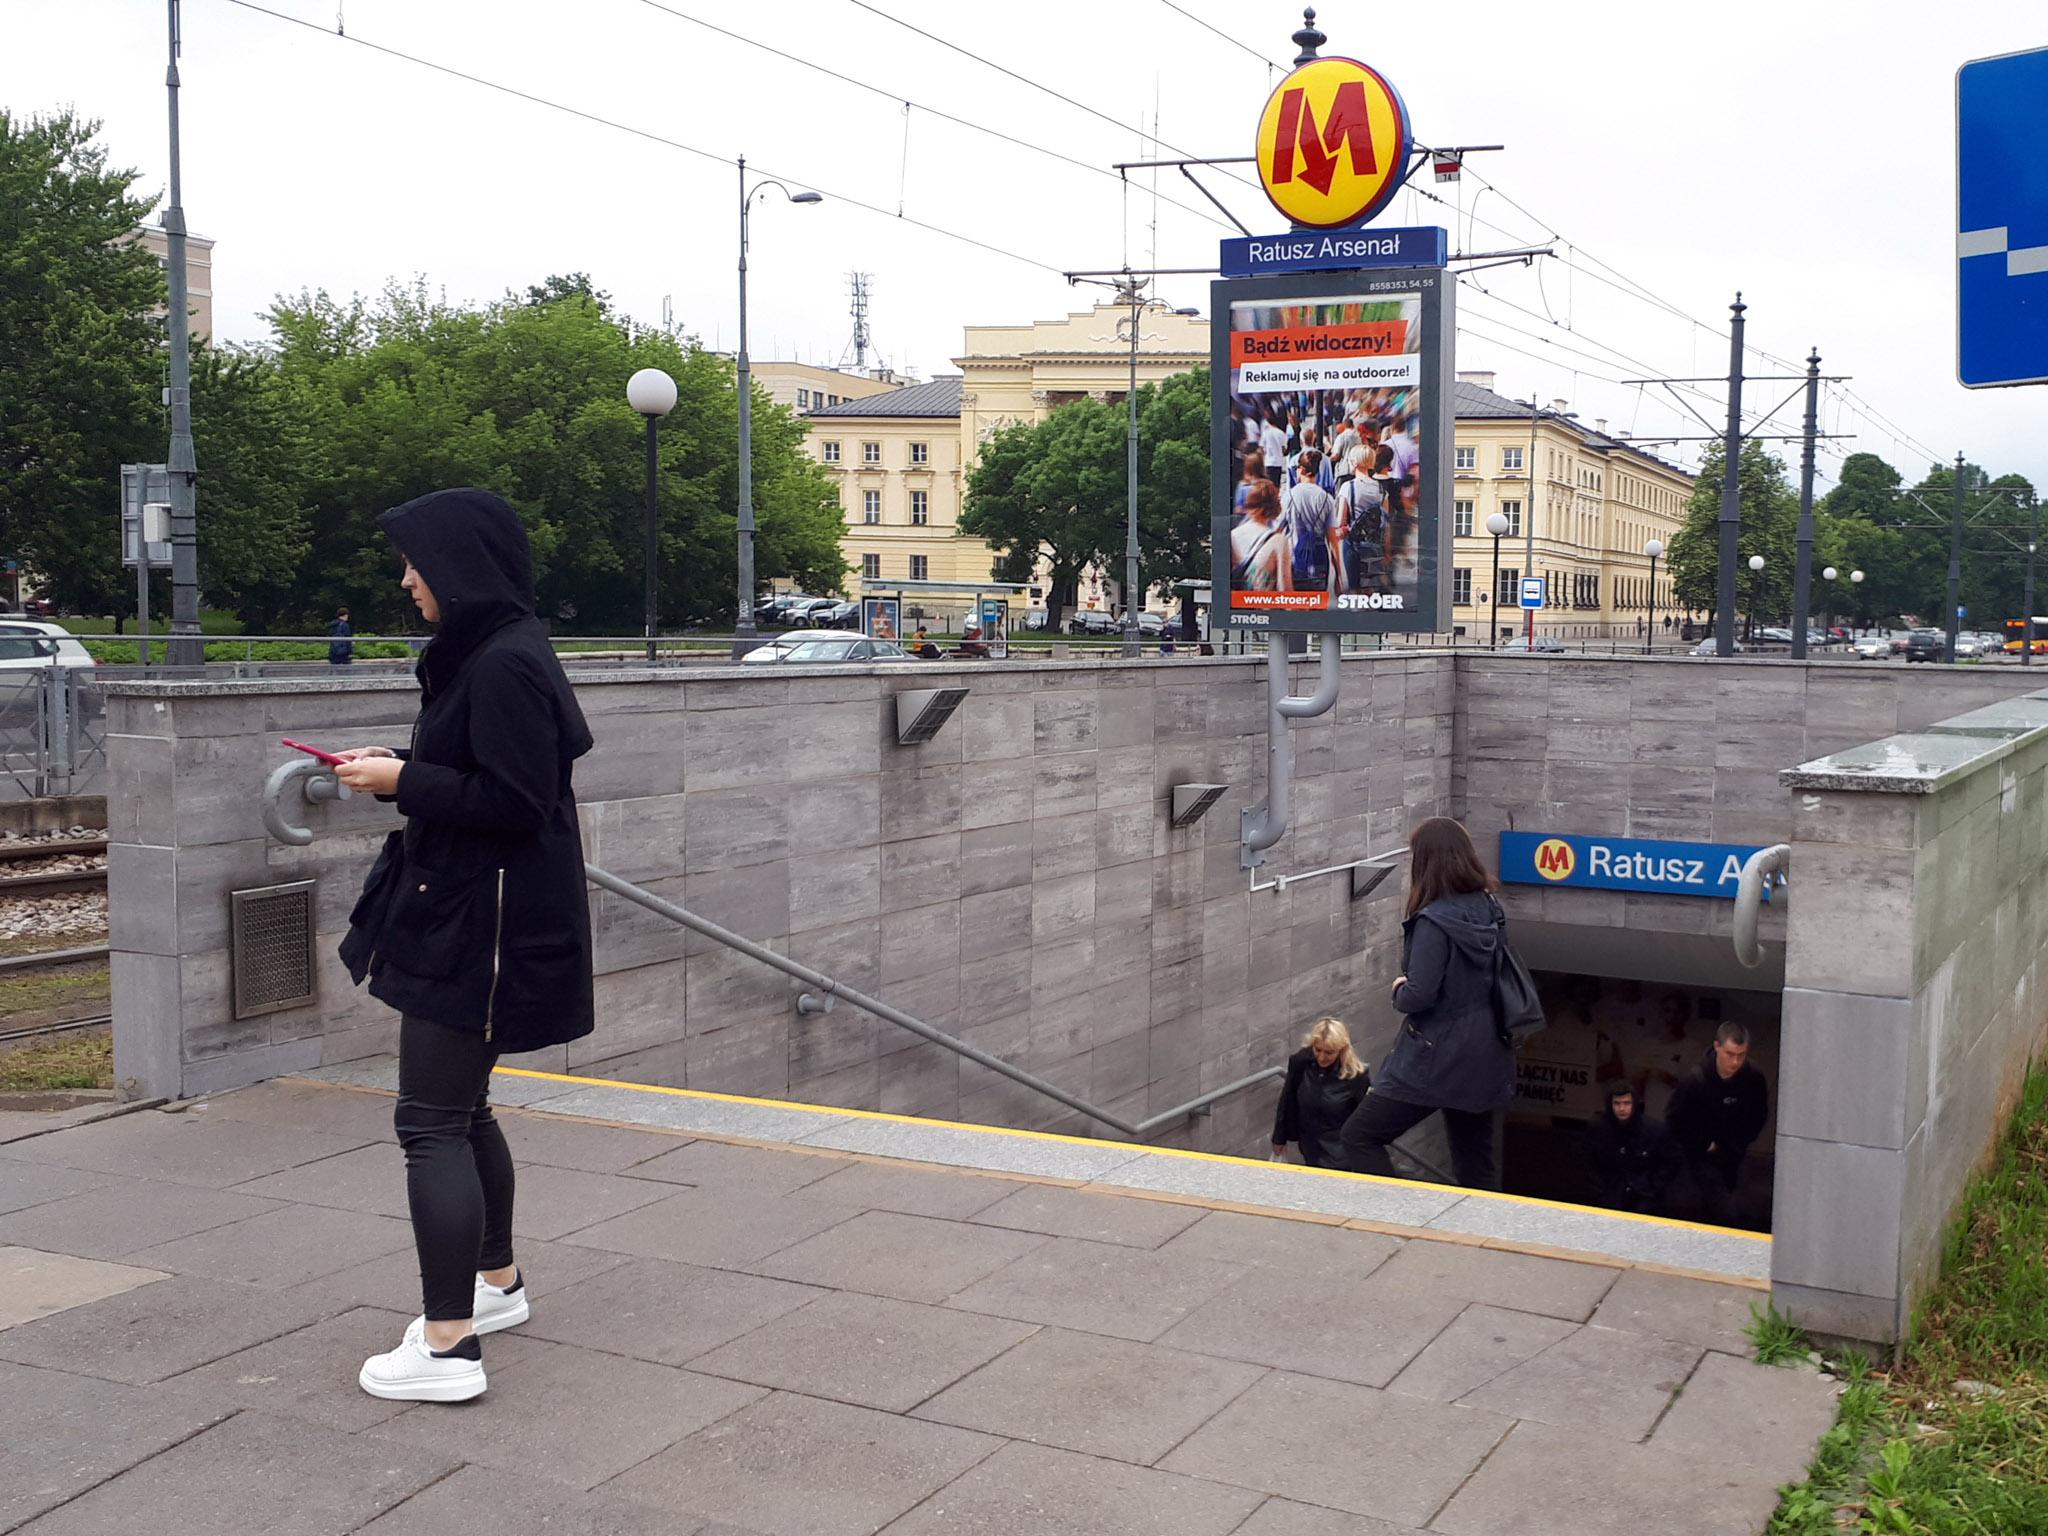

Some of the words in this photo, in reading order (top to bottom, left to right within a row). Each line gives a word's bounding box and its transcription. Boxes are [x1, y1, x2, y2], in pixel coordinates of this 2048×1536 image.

[1249, 241, 1314, 263] Ratusz
[1319, 234, 1400, 258] Arsenał
[1243, 336, 1290, 357] Bądź
[1294, 331, 1392, 353] widoczny!
[1245, 369, 1300, 383] Reklamuj
[1303, 368, 1319, 382] się
[1324, 370, 1339, 380] na
[1342, 365, 1410, 379] outdoorze!
[1243, 594, 1321, 607] www.stroer.pl
[1589, 845, 1704, 884] Ratusz
[1560, 1067, 1588, 1086] NAS
